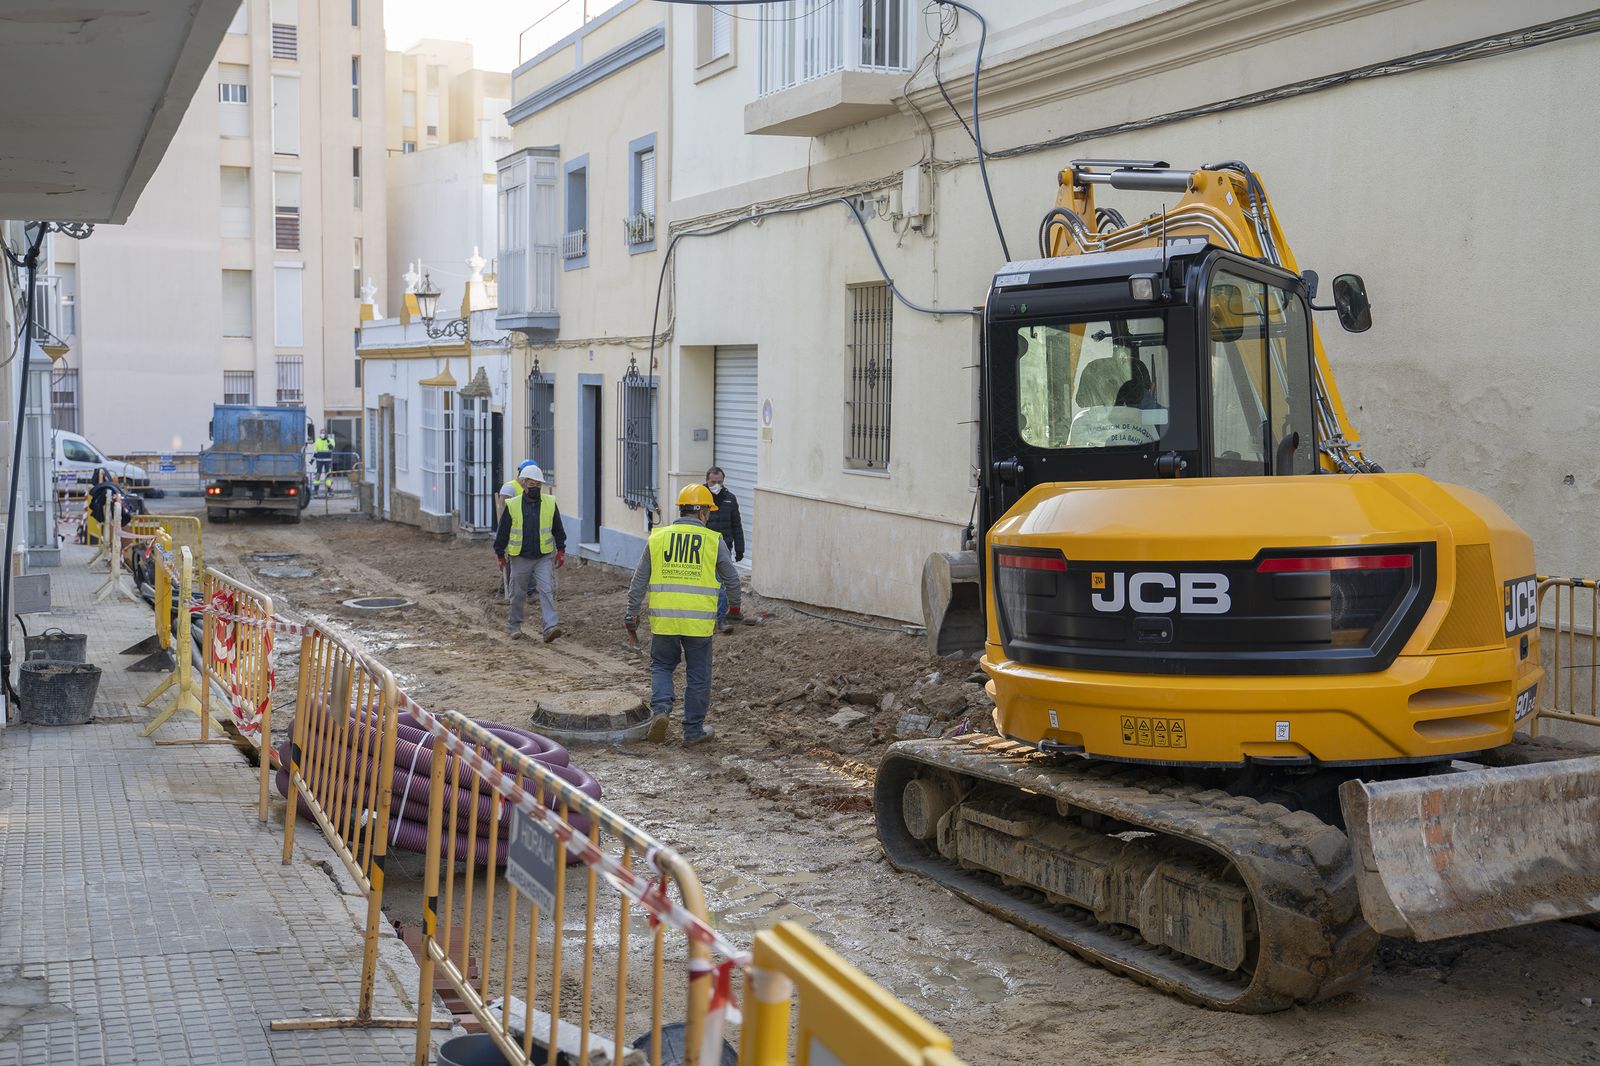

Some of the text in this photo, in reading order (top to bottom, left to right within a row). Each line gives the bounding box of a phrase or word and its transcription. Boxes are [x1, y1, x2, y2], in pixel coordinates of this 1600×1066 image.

[664, 532, 702, 564] JMR
[1091, 572, 1232, 614] JCB
[1505, 579, 1537, 632] JCB
